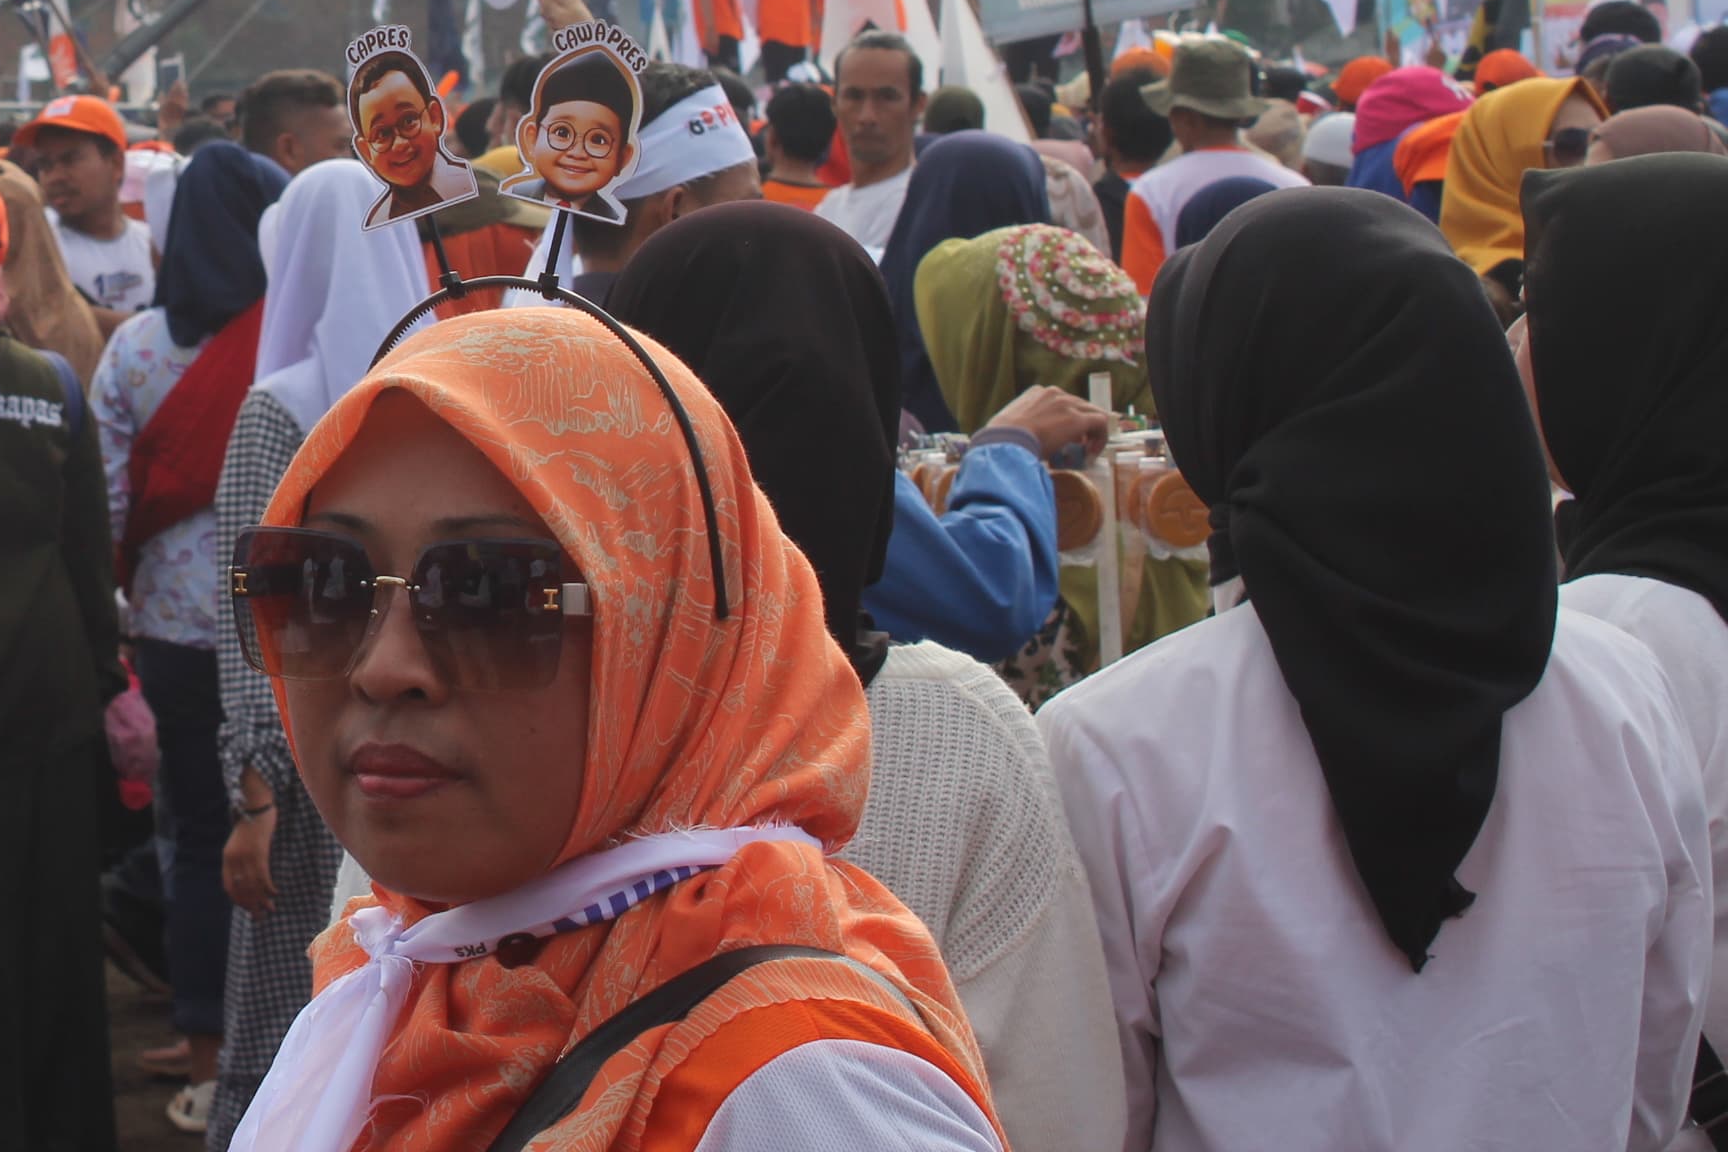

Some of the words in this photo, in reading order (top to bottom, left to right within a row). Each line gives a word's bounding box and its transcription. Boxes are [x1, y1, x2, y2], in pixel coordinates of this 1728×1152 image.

[345, 27, 410, 65] CAPRES
[554, 22, 648, 73] CAWAPRES
[454, 941, 488, 959] PKS
